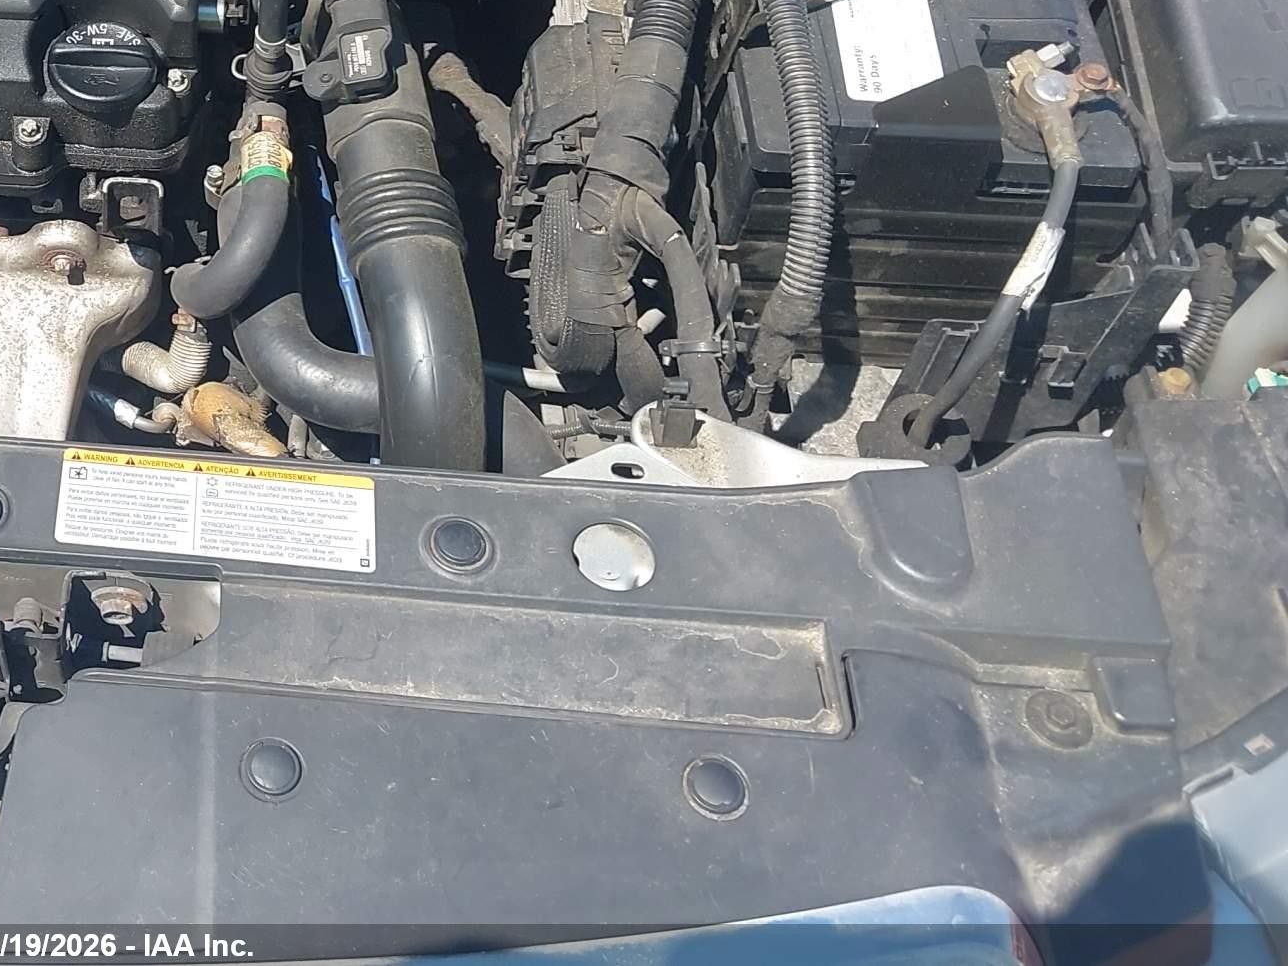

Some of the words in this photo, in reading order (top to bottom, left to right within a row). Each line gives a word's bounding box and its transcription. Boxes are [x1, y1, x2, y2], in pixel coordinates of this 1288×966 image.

[854, 45, 869, 94] Warranty:
[870, 54, 880, 79] Days
[84, 452, 118, 462] WARNING
[138, 458, 185, 469] ADVERTENCIA
[205, 464, 238, 474] ATENÇÃO
[258, 469, 316, 482] AVERTISSEMENT
